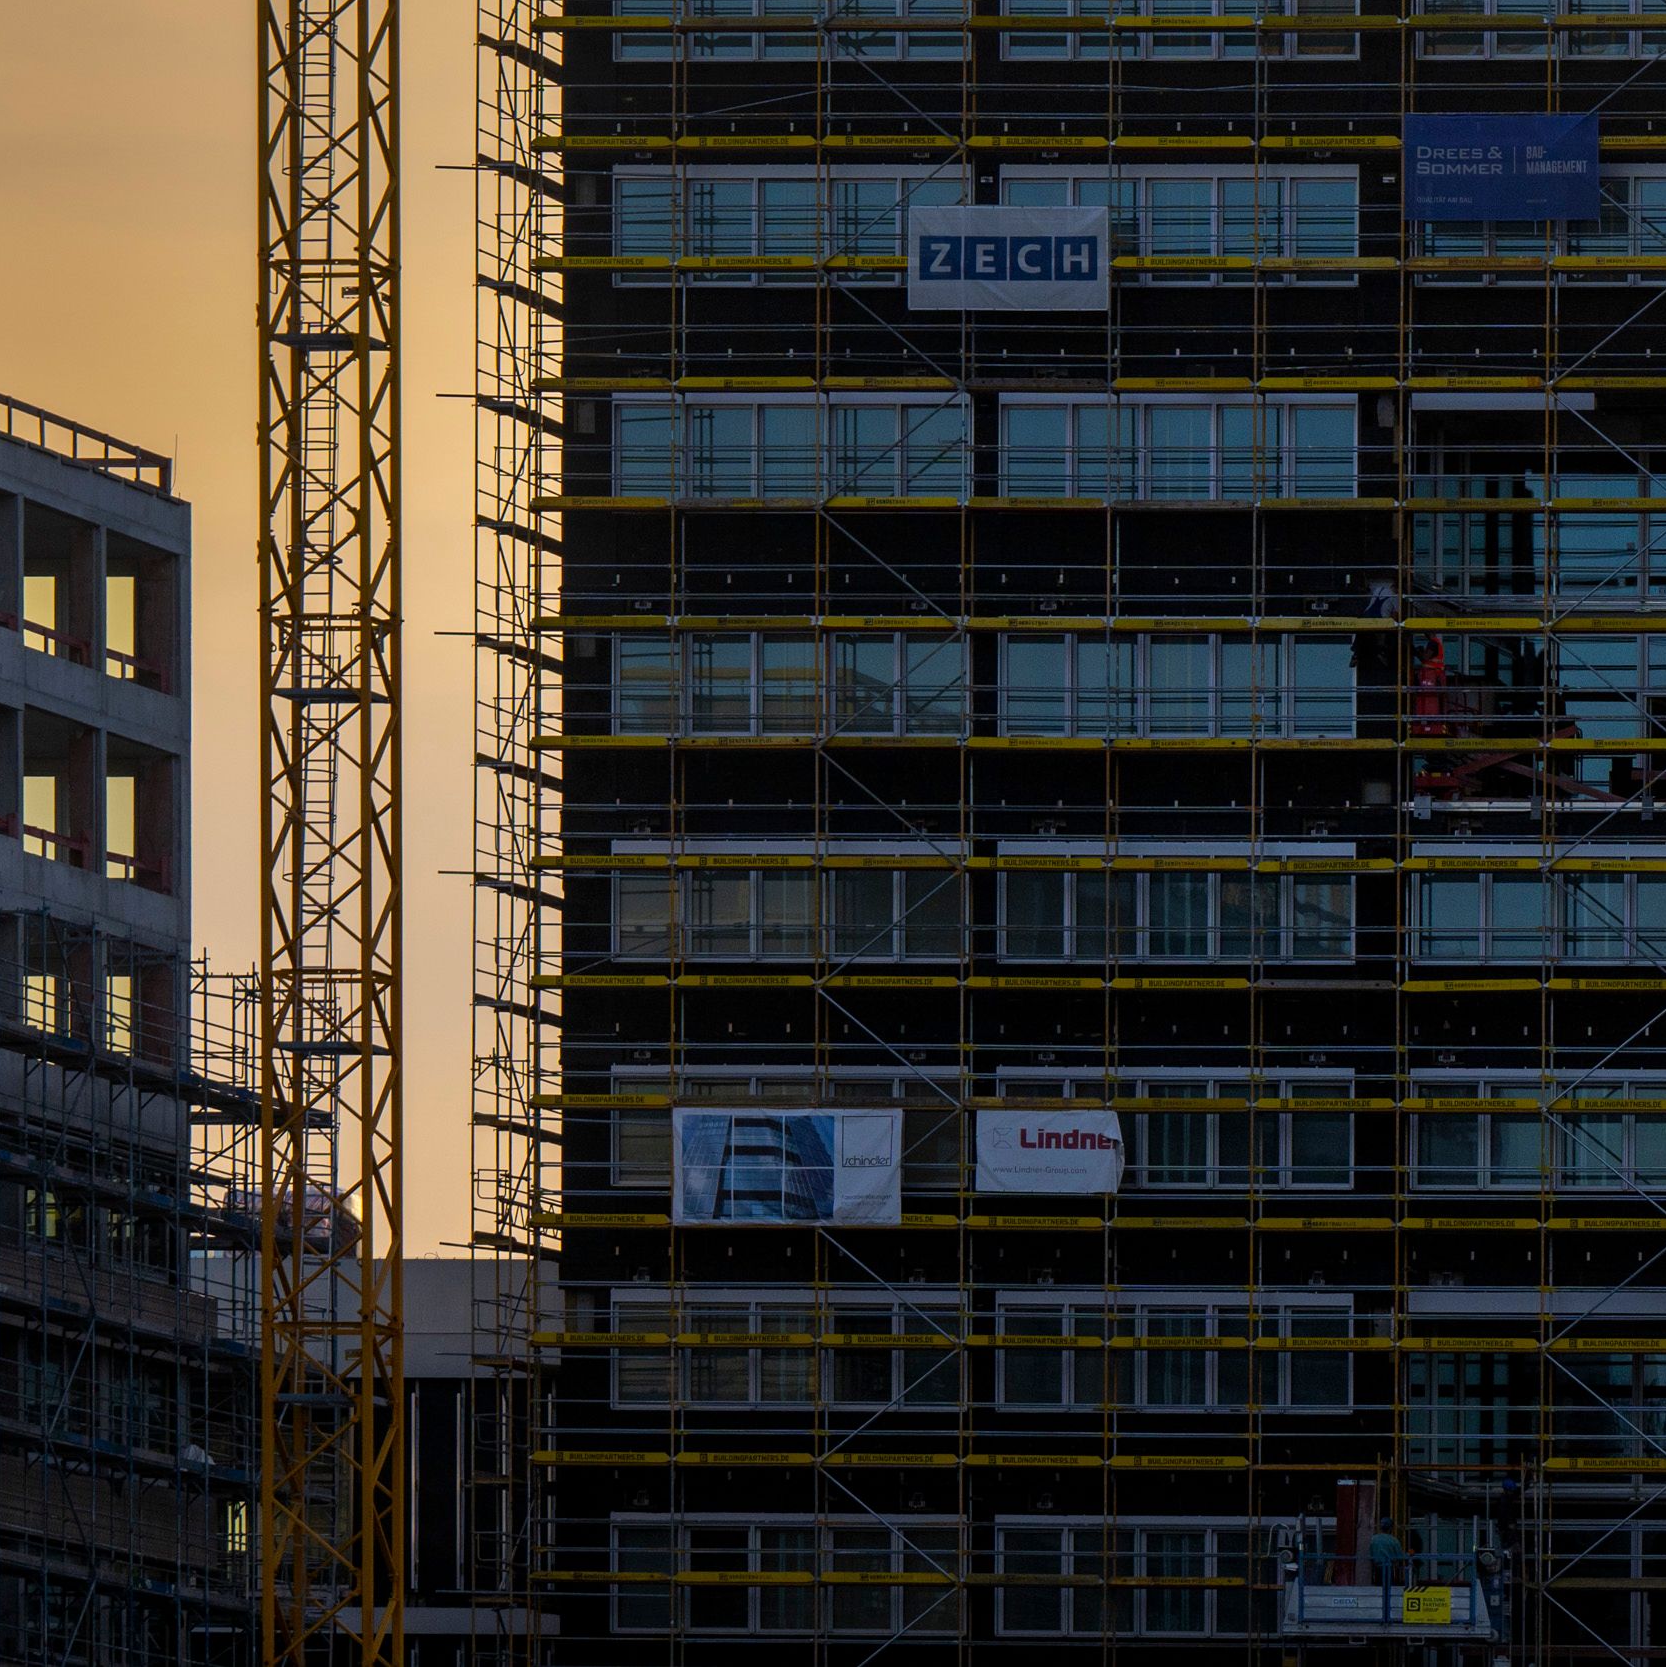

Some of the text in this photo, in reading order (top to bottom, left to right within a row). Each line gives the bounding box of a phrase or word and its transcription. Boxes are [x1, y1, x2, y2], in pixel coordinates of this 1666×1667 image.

[1416, 145, 1503, 159] DREES &
[1526, 145, 1548, 159] BAU-
[1416, 161, 1503, 175] SOMMER
[1525, 160, 1588, 175] MANAGEMENT
[928, 243, 1090, 274] ZECH
